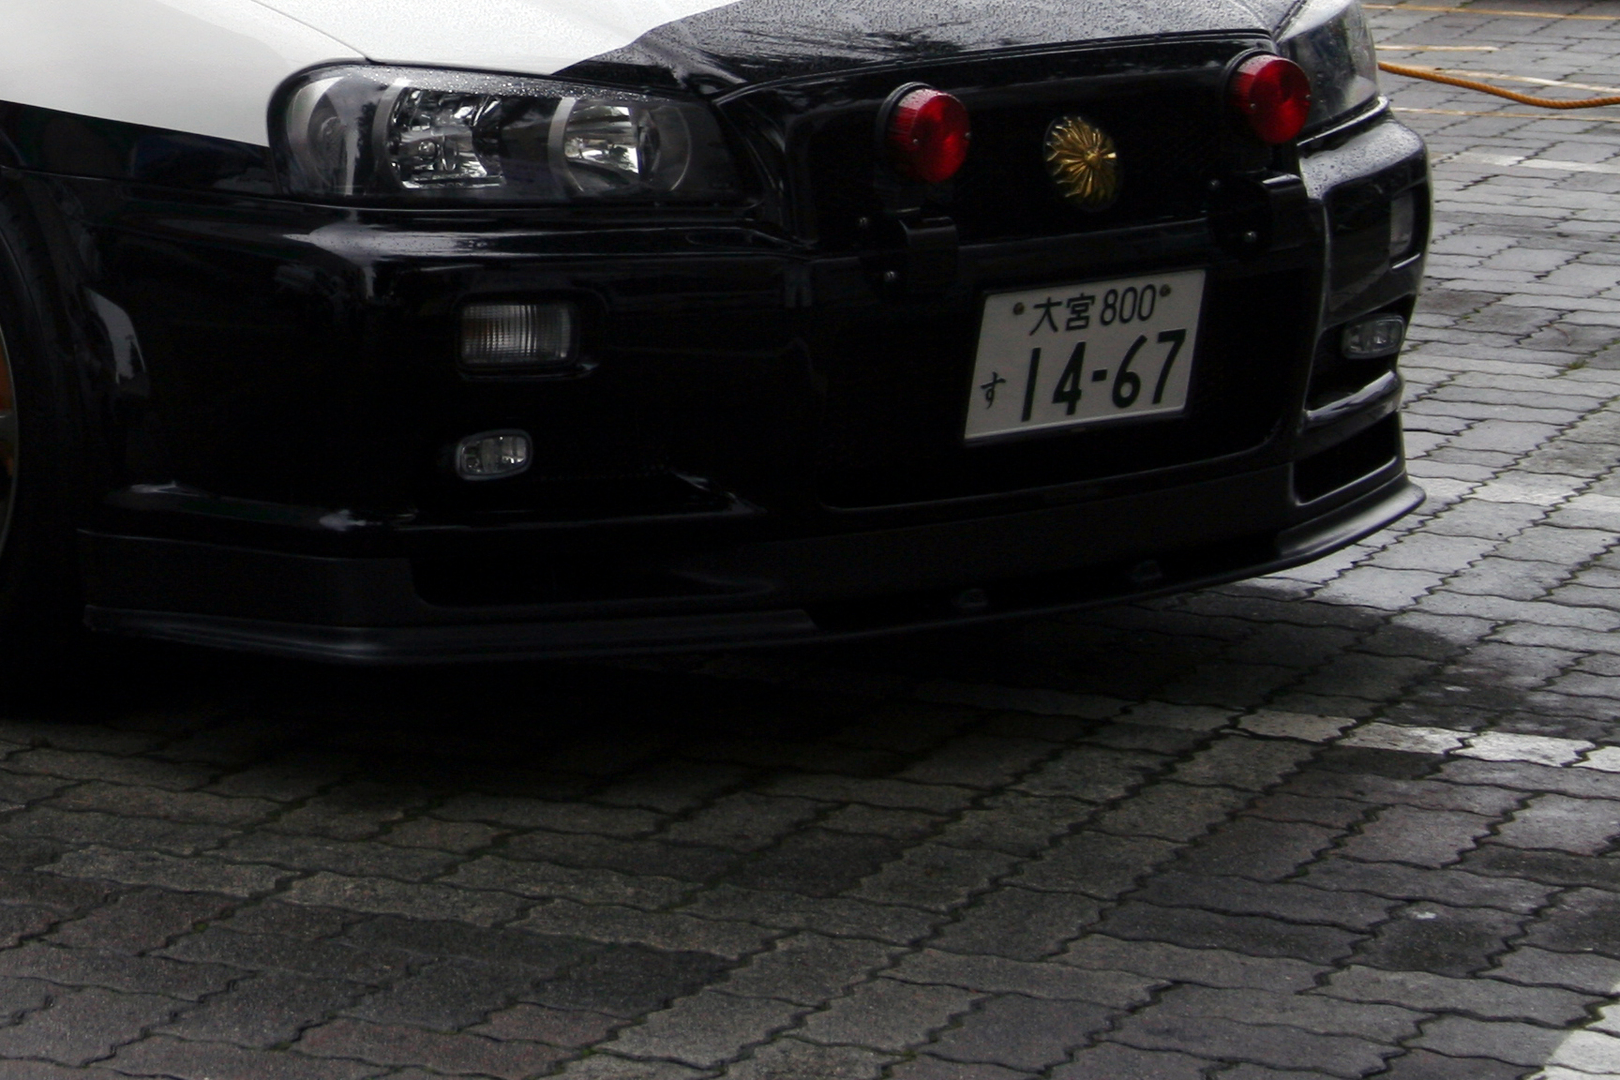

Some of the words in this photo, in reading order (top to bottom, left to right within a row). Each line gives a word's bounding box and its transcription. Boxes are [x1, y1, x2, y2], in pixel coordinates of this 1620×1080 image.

[1028, 292, 1096, 336] 大宮
[1099, 283, 1157, 327] 800
[980, 371, 1007, 410] す
[1020, 327, 1187, 423] 14-67
